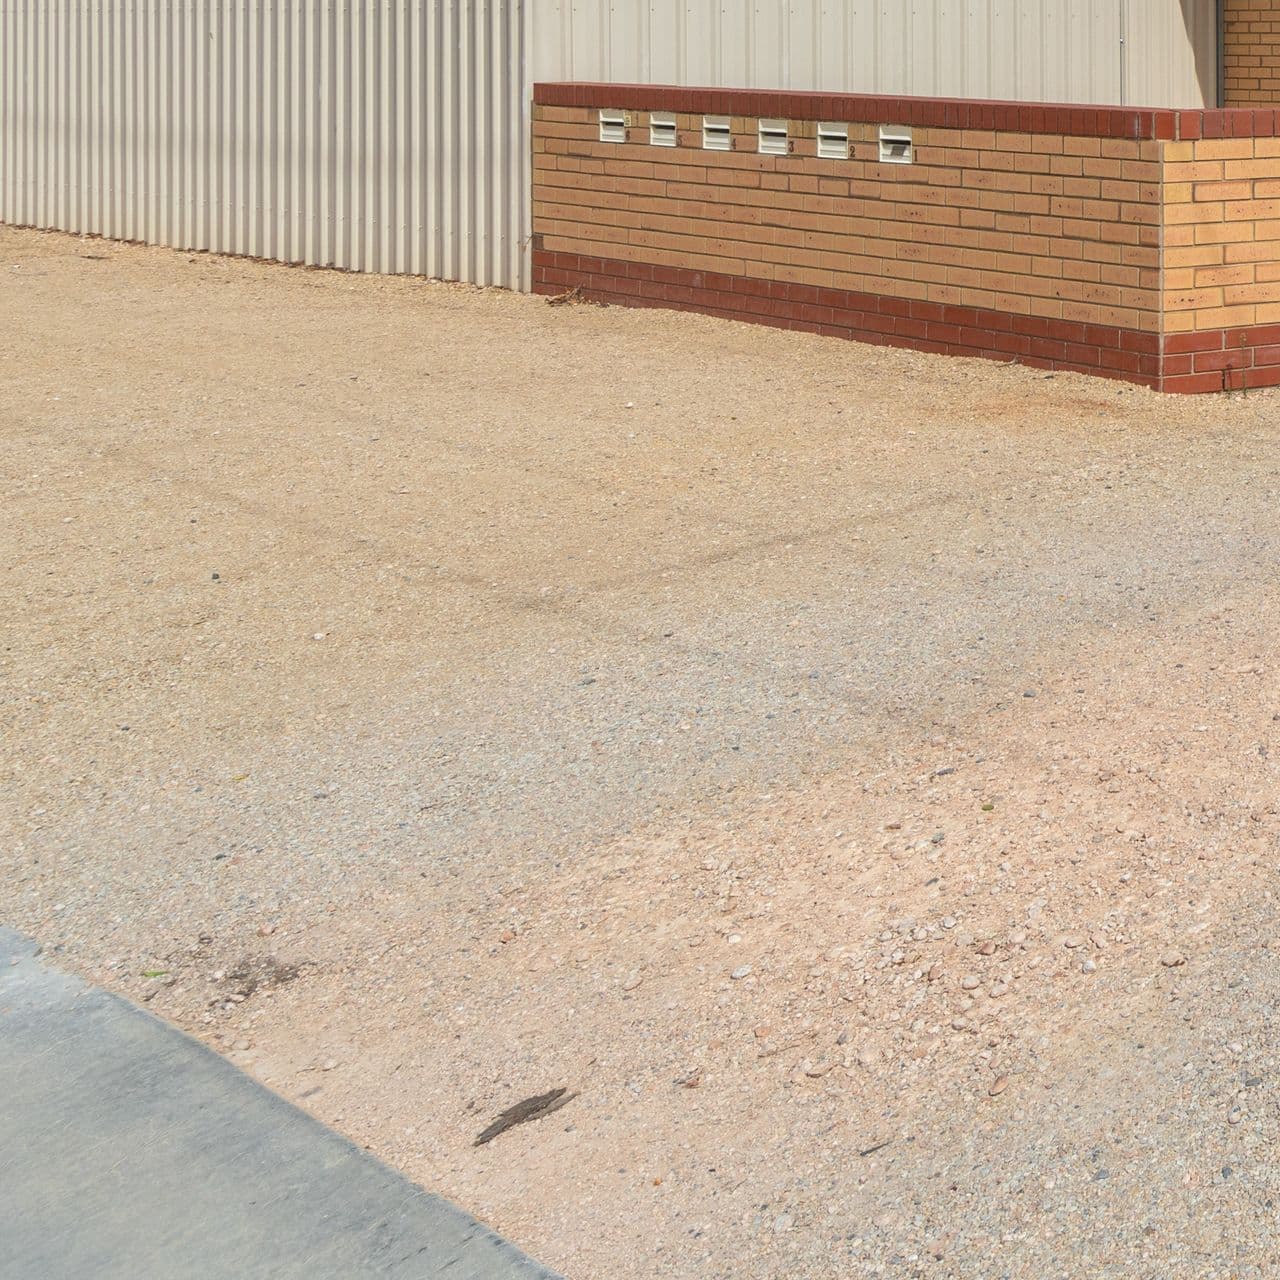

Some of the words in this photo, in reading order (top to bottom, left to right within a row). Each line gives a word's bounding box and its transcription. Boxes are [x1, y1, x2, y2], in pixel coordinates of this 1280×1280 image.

[731, 138, 737, 150] 4
[788, 140, 795, 152] 3
[849, 145, 856, 158] 2
[914, 149, 918, 162] 1
